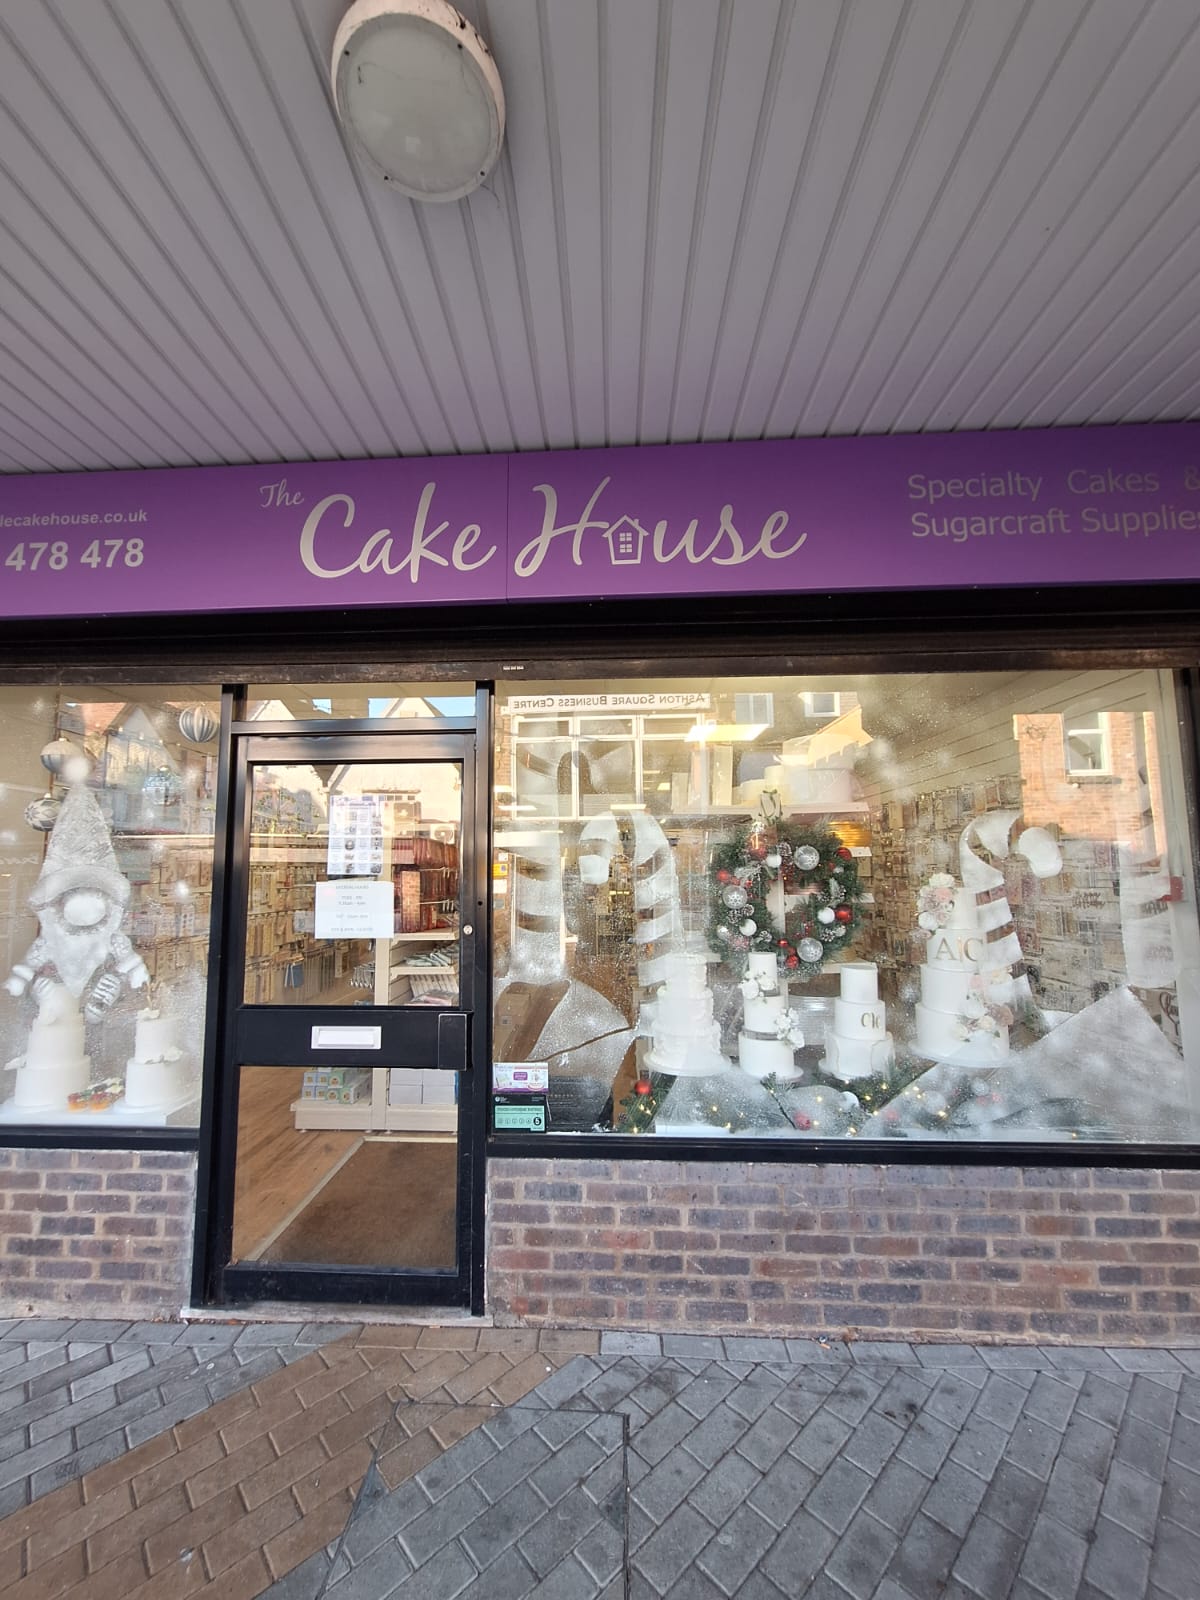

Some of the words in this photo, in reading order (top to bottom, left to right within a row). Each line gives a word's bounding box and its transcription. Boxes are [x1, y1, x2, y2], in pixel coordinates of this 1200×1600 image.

[259, 478, 304, 508] The
[908, 470, 1042, 504] Specialty
[1067, 467, 1160, 494] Cakes
[300, 482, 497, 583] Cake
[911, 507, 1072, 542] Sugarcraft
[1081, 503, 1200, 538] Supplie
[5, 540, 69, 571] 478
[80, 538, 144, 568] 478
